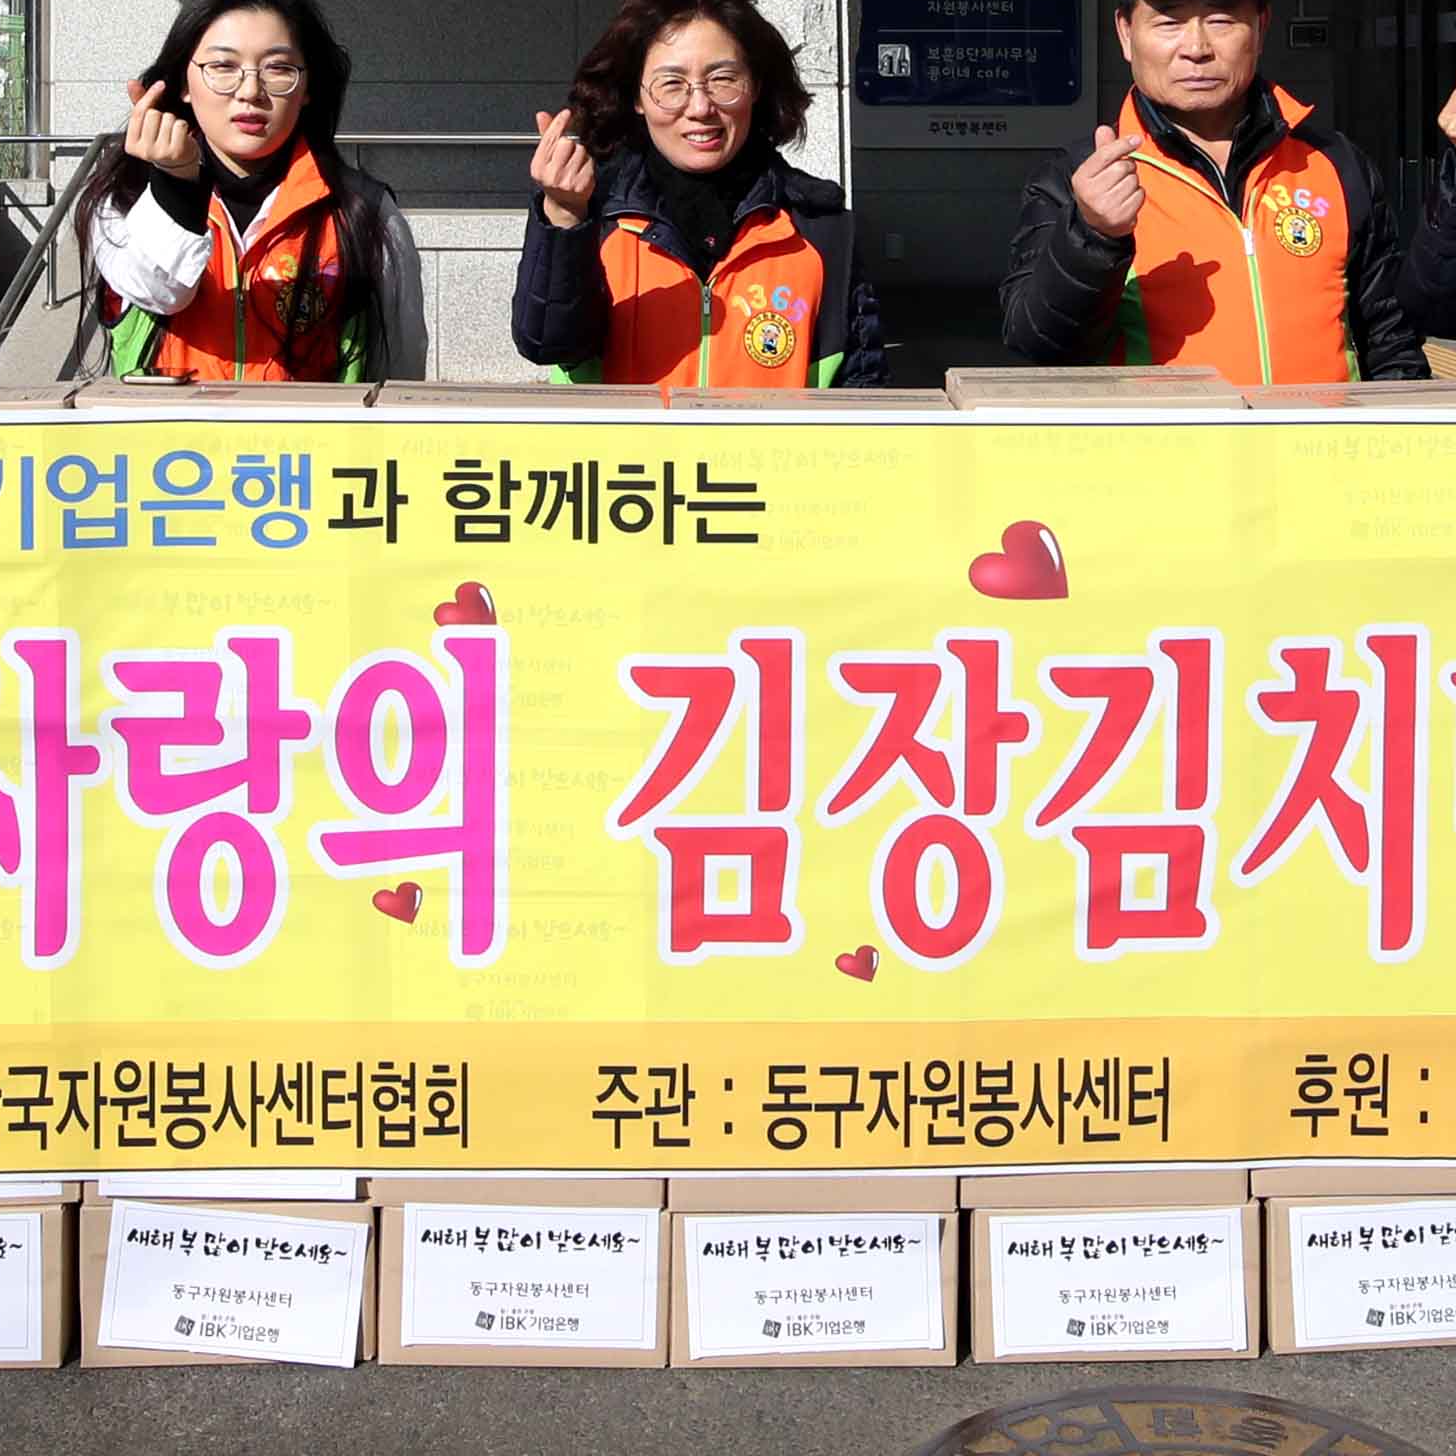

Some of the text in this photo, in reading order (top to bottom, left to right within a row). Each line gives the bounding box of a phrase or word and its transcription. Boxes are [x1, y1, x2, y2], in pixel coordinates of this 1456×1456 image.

[1261, 185, 1331, 217] 1365
[731, 284, 809, 321] 1365
[442, 457, 767, 545] 함께하는
[591, 1063, 694, 1149] 주관
[760, 1058, 1173, 1145] 동구자원봉사센터
[1288, 1051, 1392, 1138] 후원
[126, 1228, 175, 1251] 새해
[179, 1228, 198, 1257] 복
[203, 1231, 249, 1257] 많이
[420, 1228, 468, 1249] 새해
[473, 1226, 491, 1253] 복
[497, 1227, 542, 1253] 많이
[702, 1239, 749, 1259] 새해
[755, 1235, 772, 1262] 복
[778, 1235, 823, 1260] 많이
[1007, 1239, 1054, 1258] 새해
[1059, 1235, 1076, 1262] 복
[1082, 1235, 1127, 1260] 많이
[1307, 1230, 1353, 1249] 새해
[1359, 1226, 1375, 1252] 복
[1381, 1224, 1425, 1249] 많이
[172, 1283, 293, 1309] 동구자원봉사센터
[469, 1281, 589, 1299] 동구자원봉사센터
[754, 1286, 873, 1306] 동구자원봉사센터
[1058, 1285, 1177, 1305] 동구자원봉사센터
